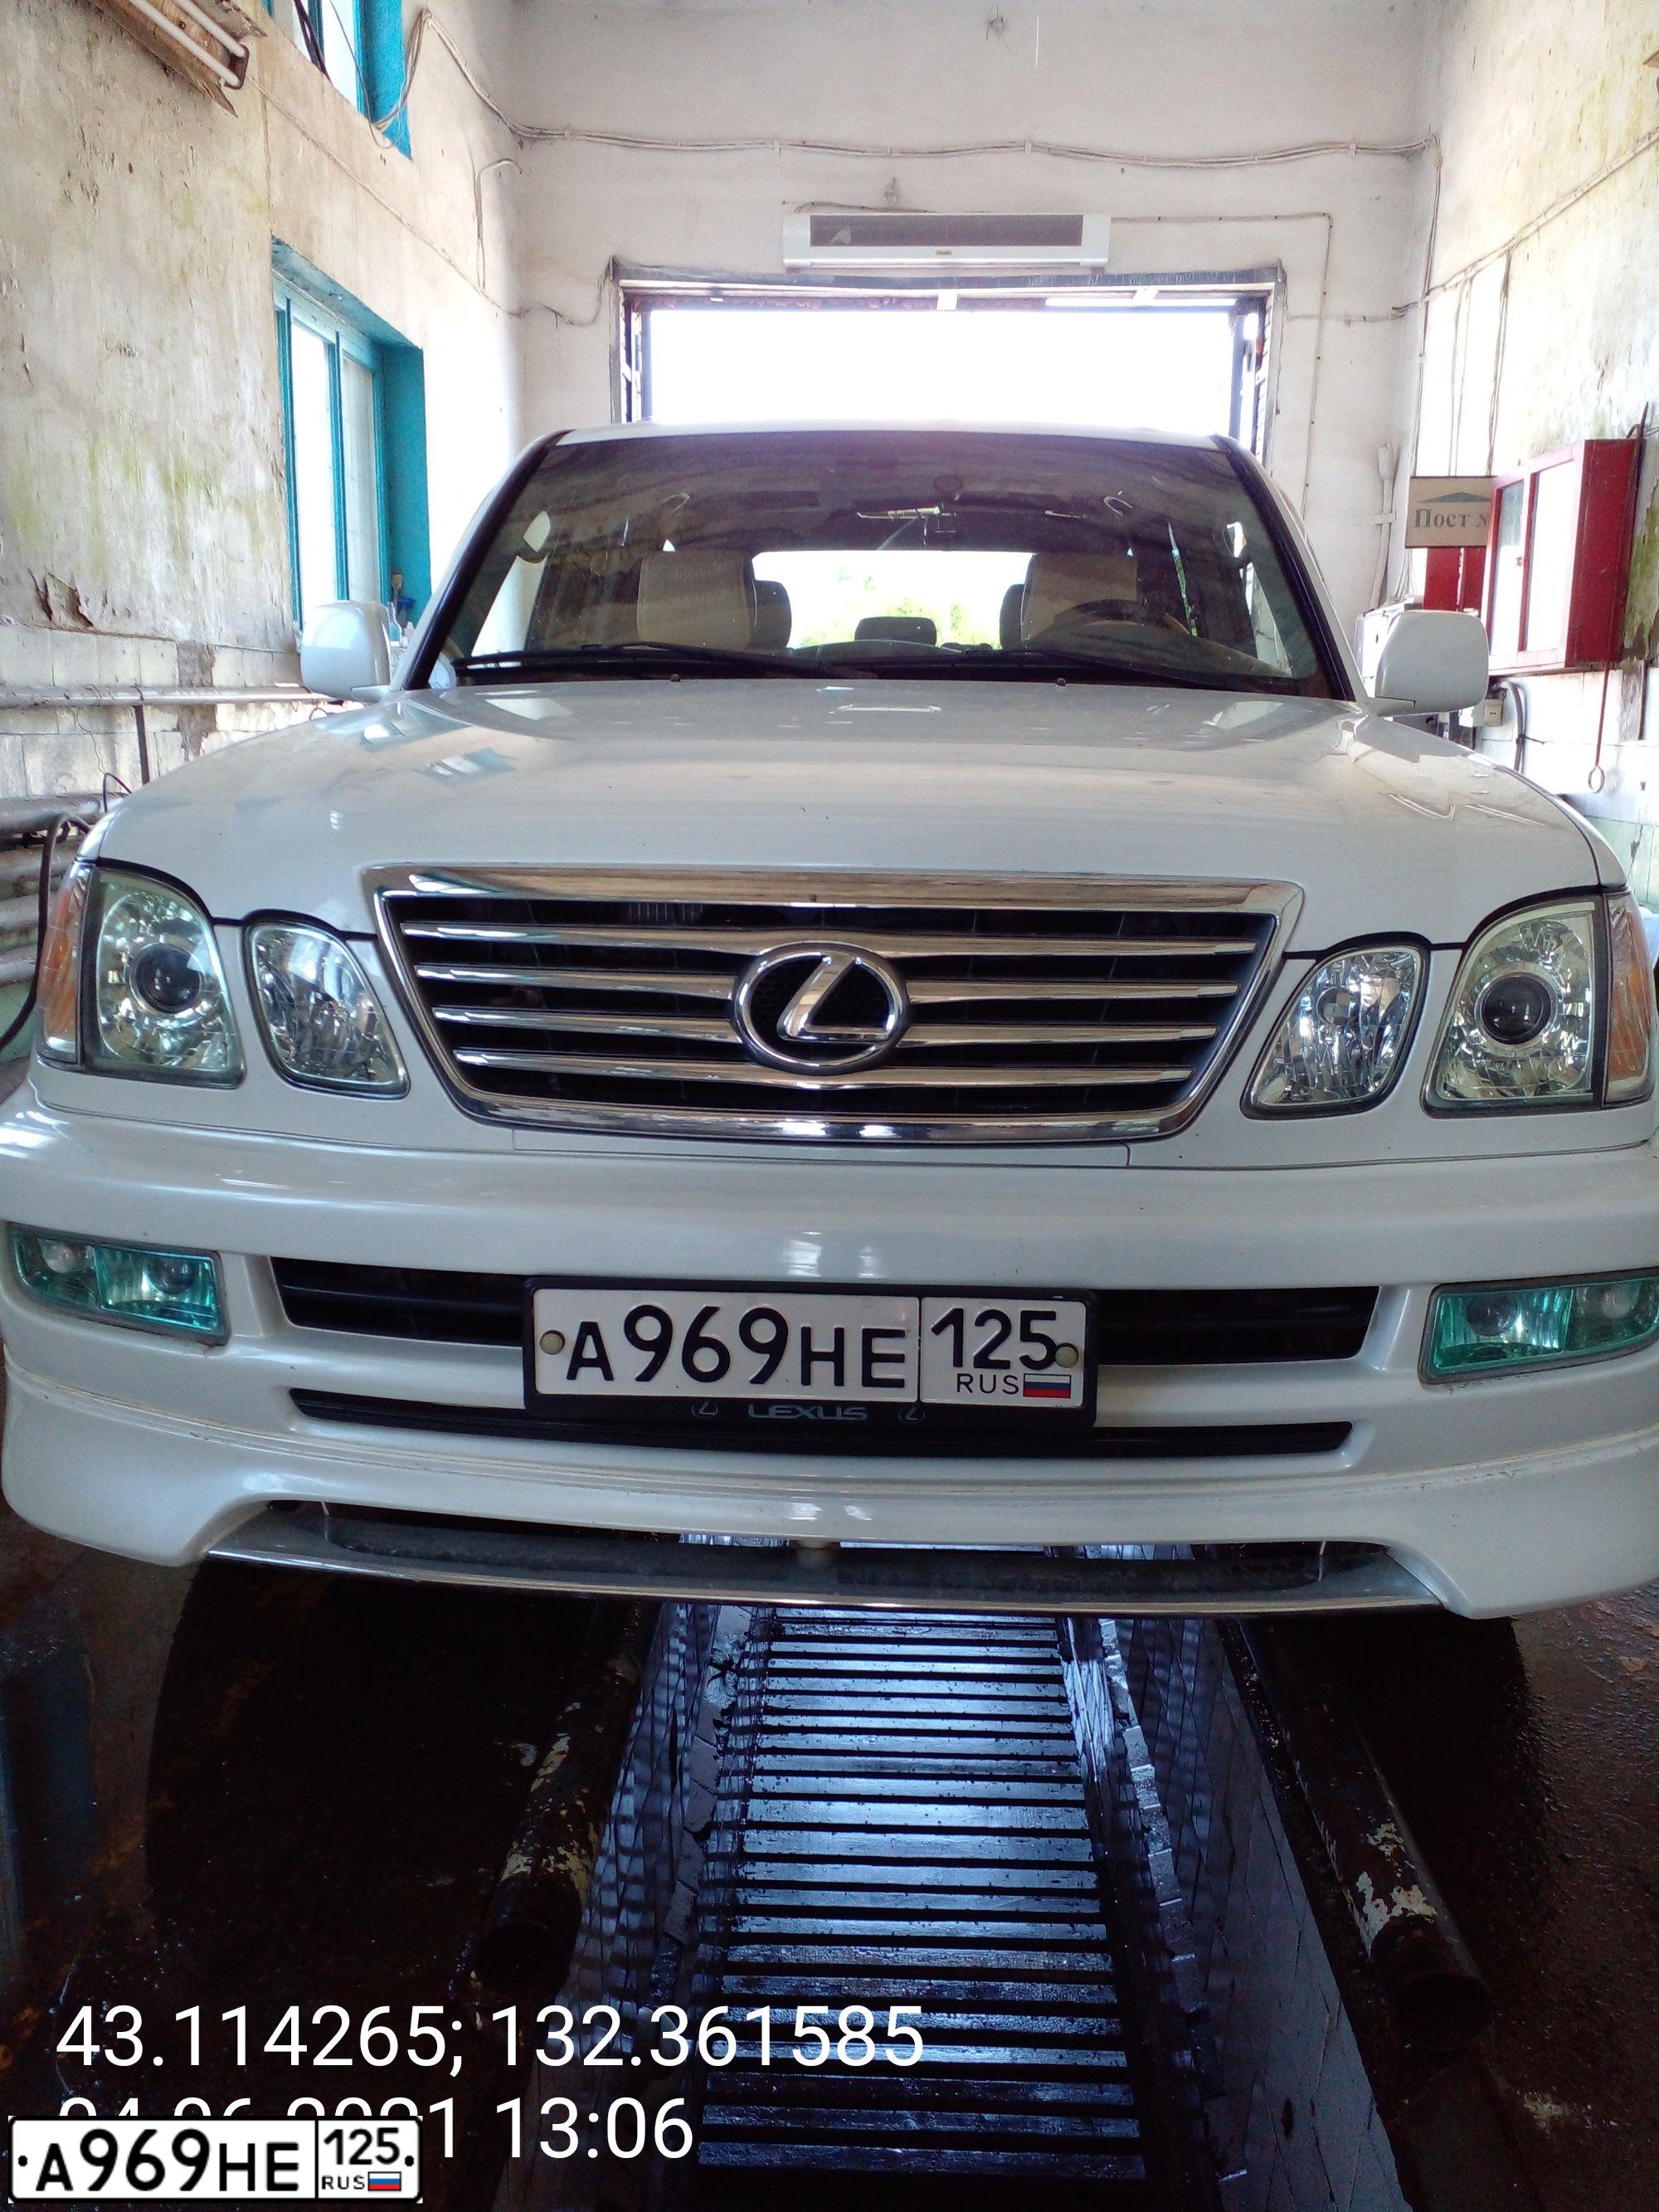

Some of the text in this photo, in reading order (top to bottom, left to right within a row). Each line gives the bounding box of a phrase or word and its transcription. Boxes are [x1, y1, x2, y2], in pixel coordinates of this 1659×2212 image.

[1414, 508, 1470, 528] Пост
[931, 1308, 1058, 1371] 125
[956, 1373, 1019, 1395] RUS
[748, 1404, 868, 1420] LEXUS
